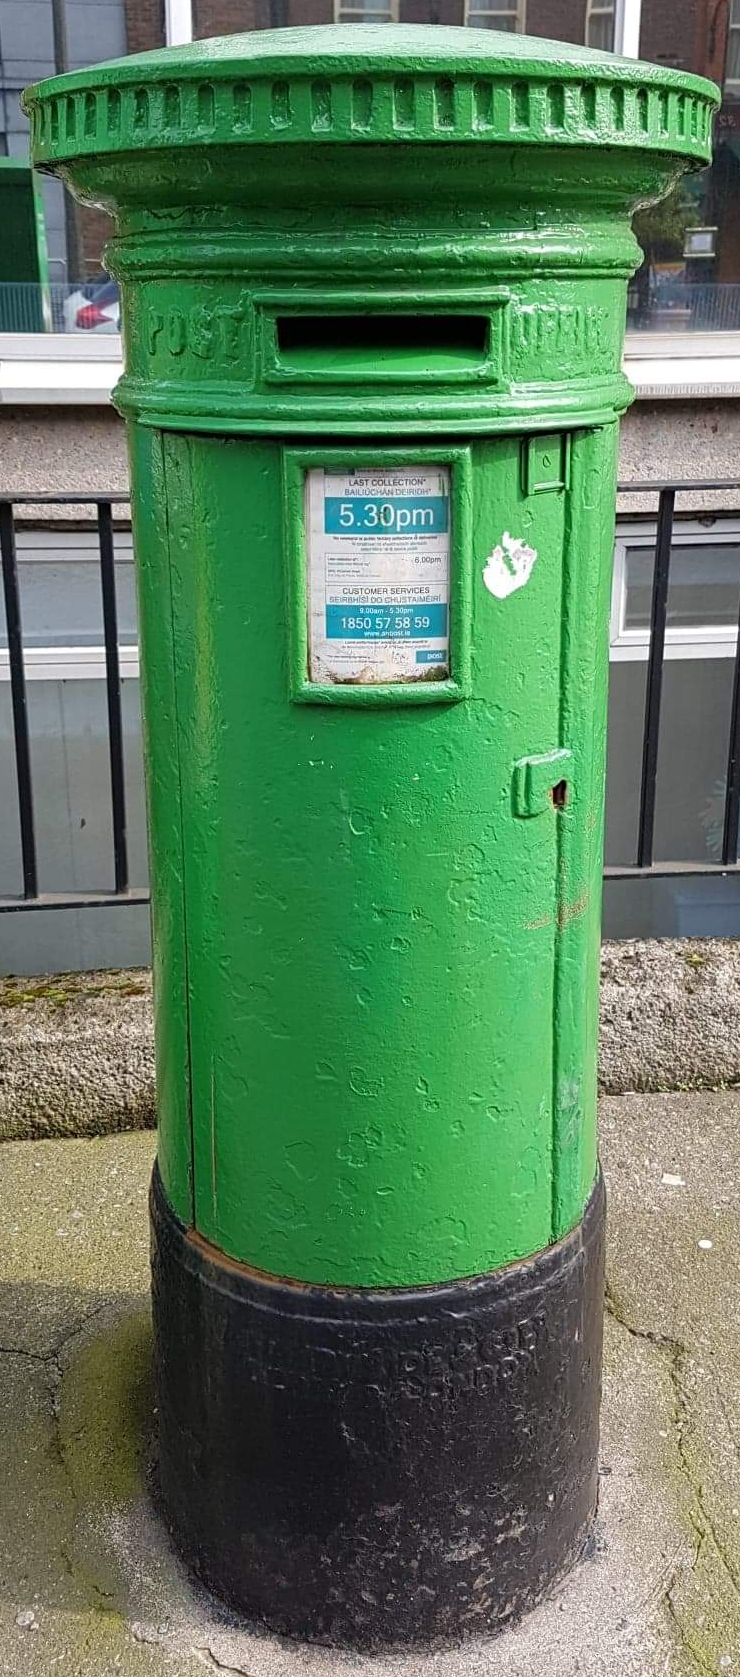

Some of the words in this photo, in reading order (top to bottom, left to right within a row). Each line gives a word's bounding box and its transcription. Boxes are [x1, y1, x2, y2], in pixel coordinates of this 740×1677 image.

[349, 479, 370, 487] LAST
[340, 503, 434, 532] 5.30pm
[342, 587, 388, 595] CUSTOMER
[390, 587, 430, 595] SERVICES
[370, 596, 383, 604] DO
[341, 617, 371, 629] 1850
[375, 617, 391, 629] 57
[394, 617, 411, 628] 58
[414, 616, 430, 628] 59
